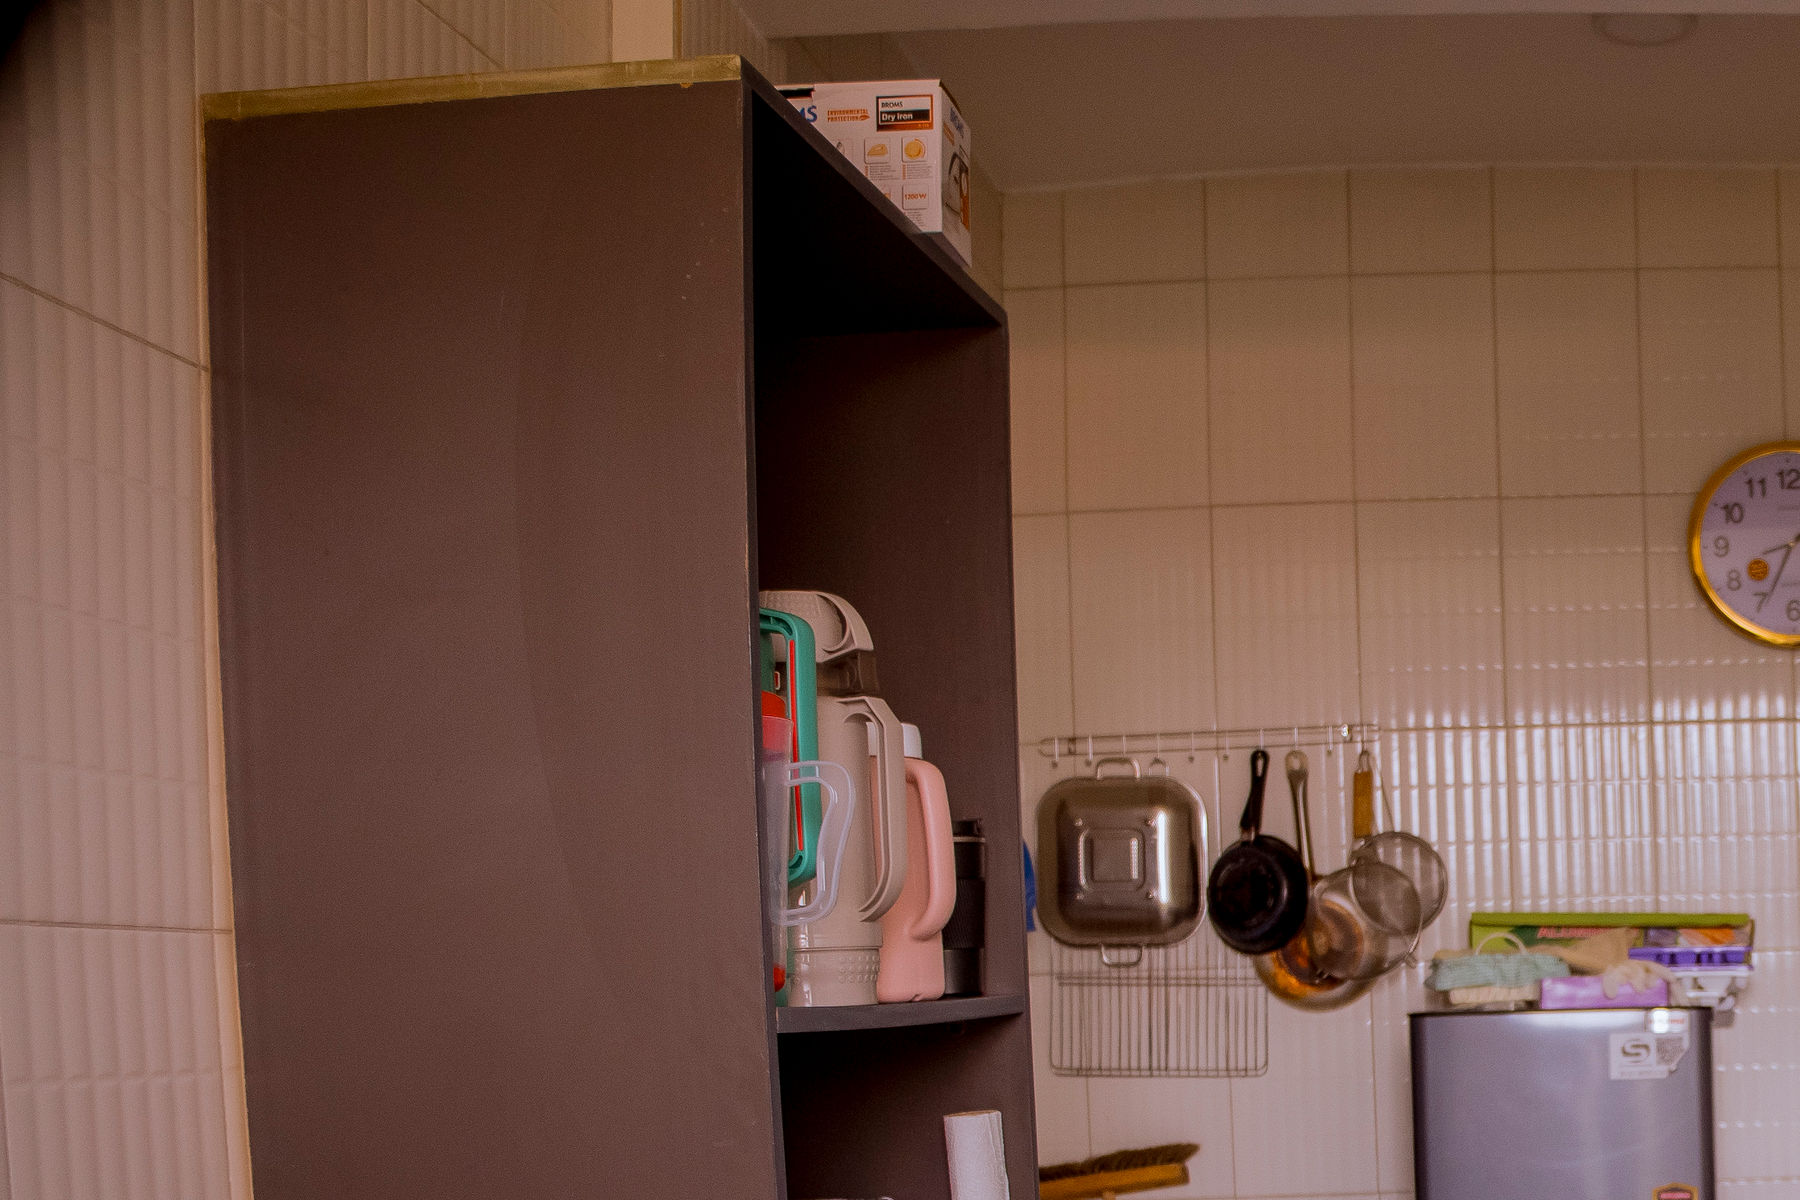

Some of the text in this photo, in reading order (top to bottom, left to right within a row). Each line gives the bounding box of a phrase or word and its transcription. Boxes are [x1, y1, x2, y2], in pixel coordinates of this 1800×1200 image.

[882, 113, 895, 121] Dry
[1745, 477, 1767, 498] 11
[1777, 469, 1800, 490] 12
[1721, 502, 1744, 524] 10
[1713, 536, 1729, 557] 9
[1727, 569, 1741, 591] 8
[1753, 592, 1768, 613] 7
[1786, 600, 1800, 621] 6
